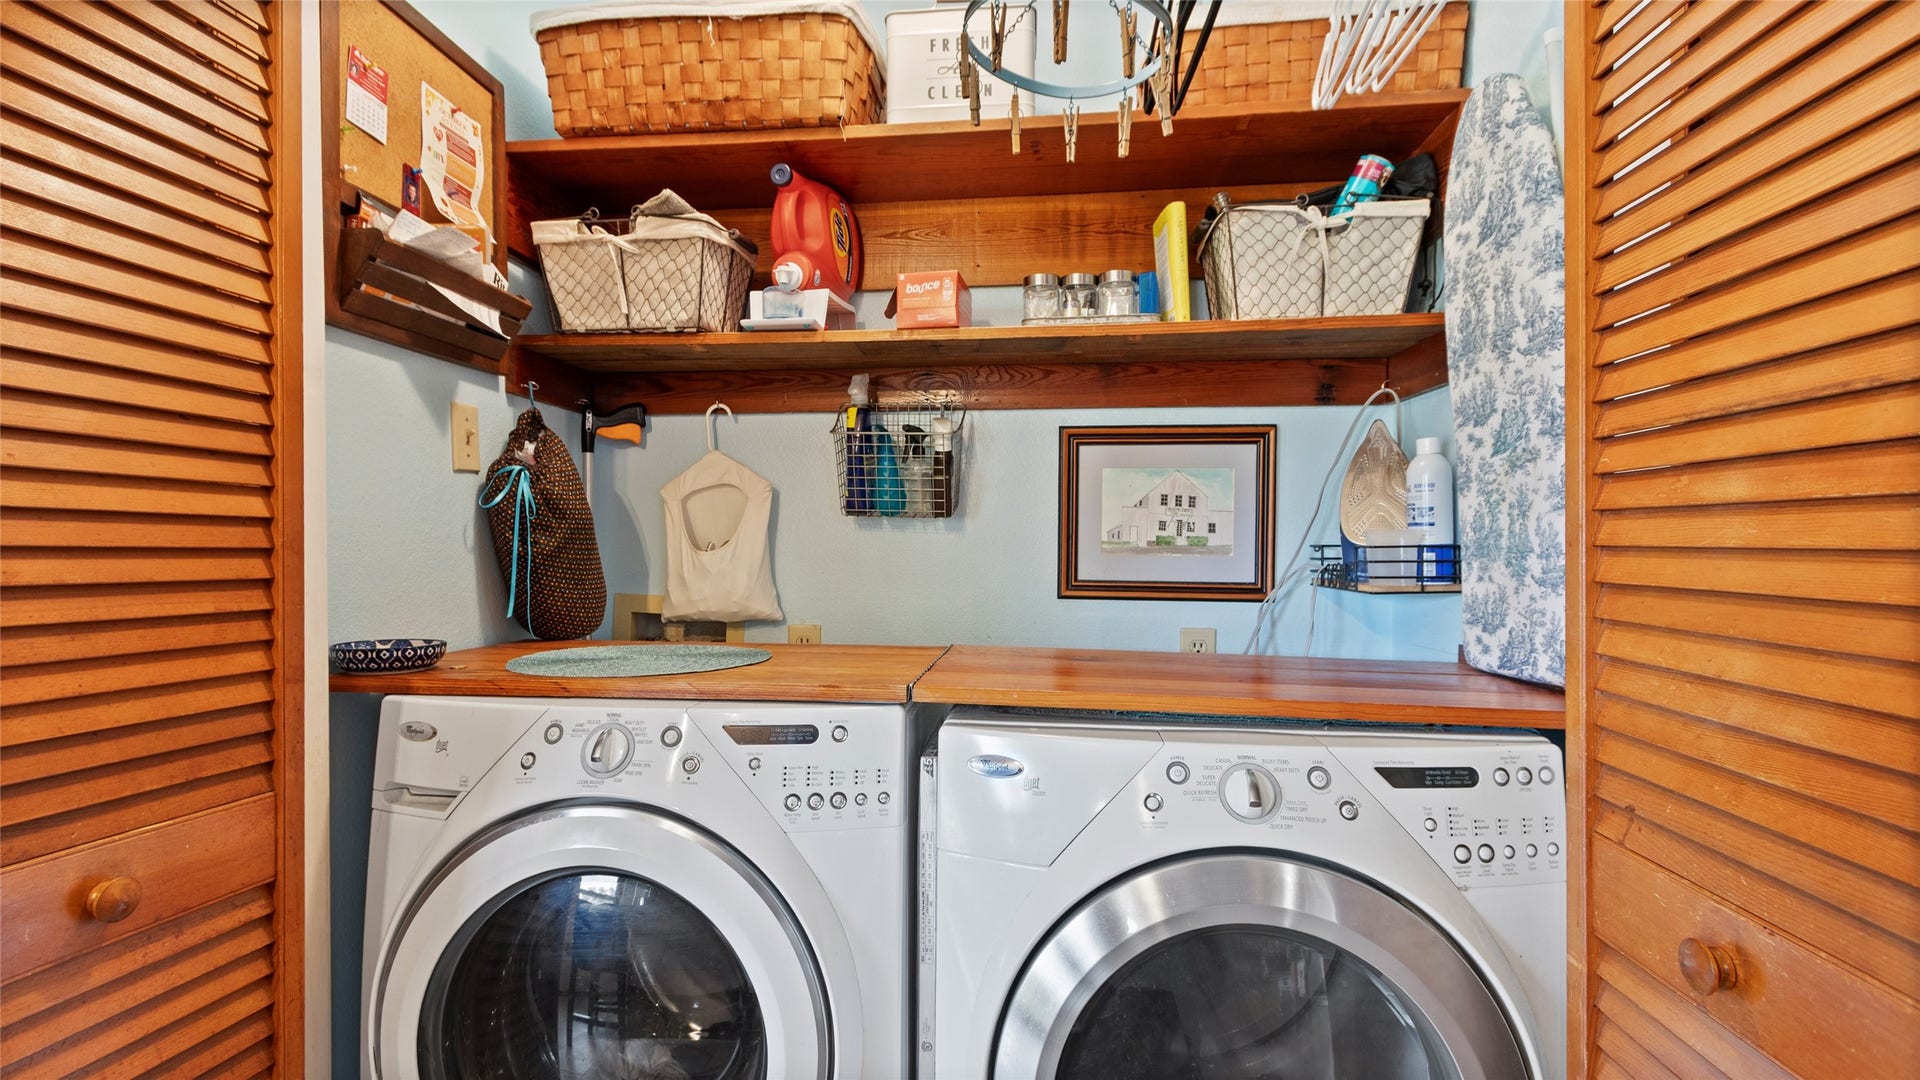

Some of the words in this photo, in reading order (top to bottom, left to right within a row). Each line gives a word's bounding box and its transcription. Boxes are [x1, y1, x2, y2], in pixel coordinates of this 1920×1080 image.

[930, 35, 989, 53] FREH
[928, 83, 993, 99] CLEN
[833, 212, 848, 253] Tide
[906, 280, 941, 294] bounce
